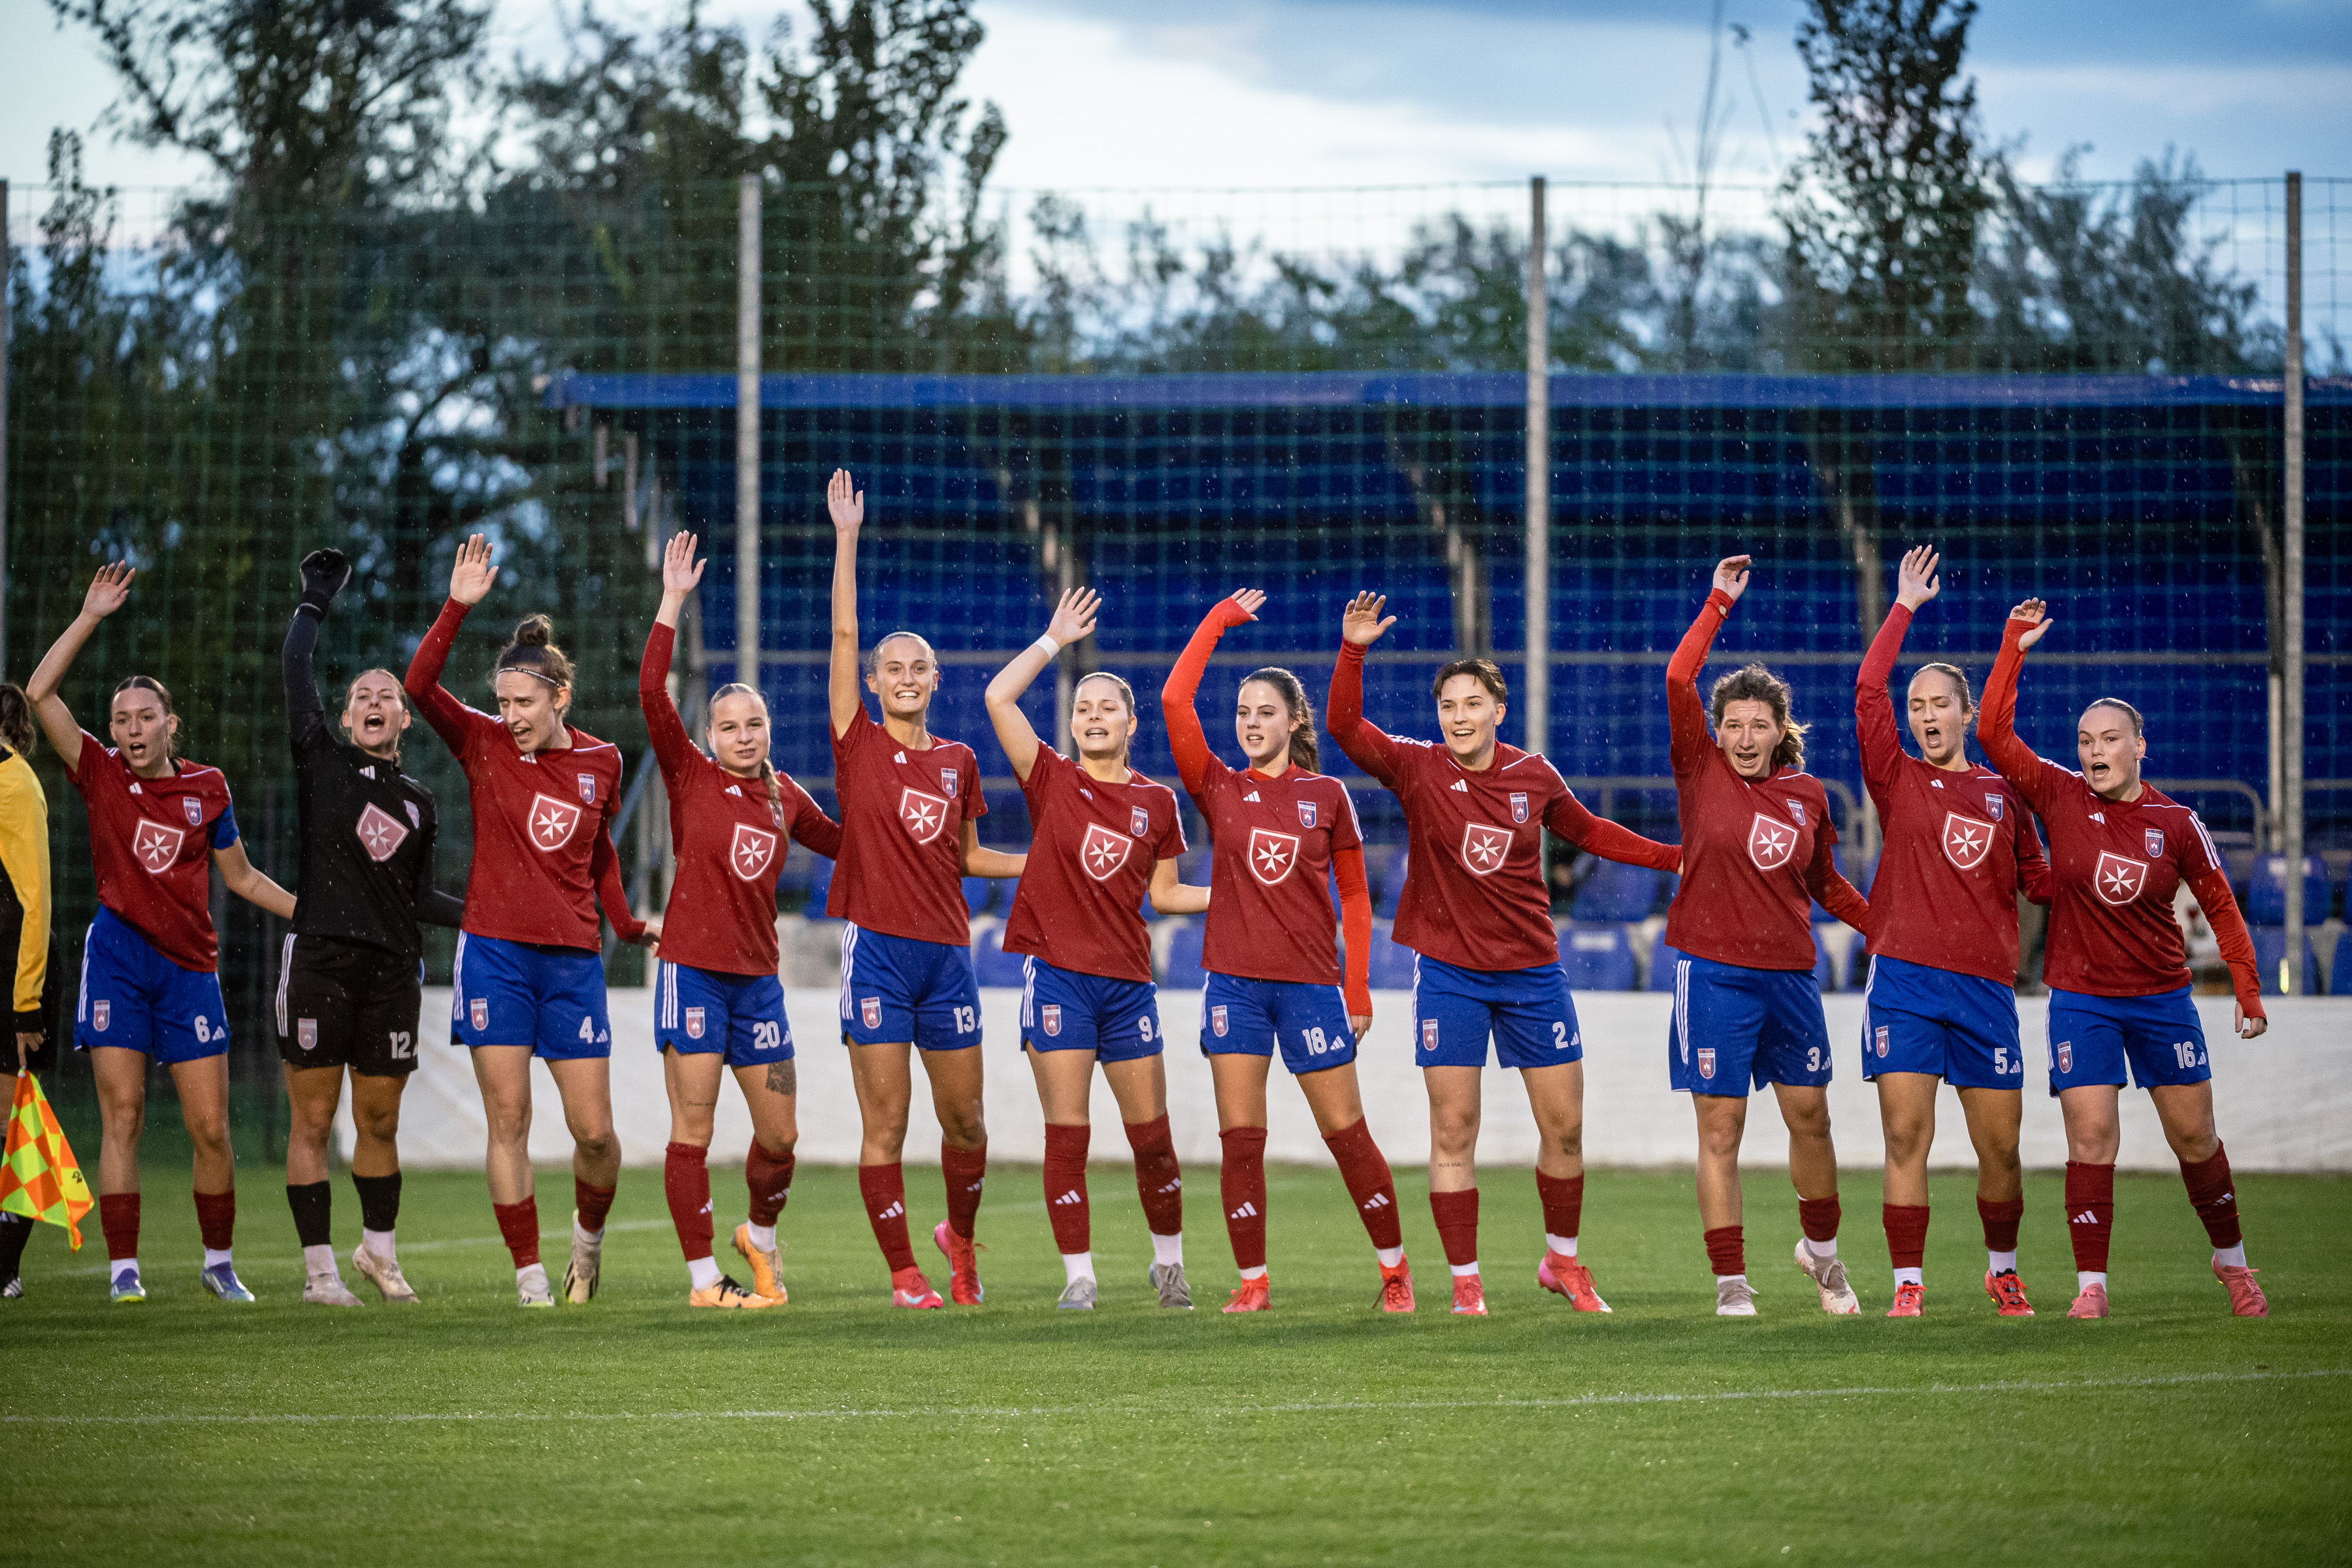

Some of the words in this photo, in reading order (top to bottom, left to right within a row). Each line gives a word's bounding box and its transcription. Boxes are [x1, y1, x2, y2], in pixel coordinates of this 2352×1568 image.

[195, 1015, 210, 1043] 6
[579, 1016, 595, 1044] 4
[953, 1005, 975, 1034] 13
[1138, 1015, 1153, 1043] 9
[389, 1032, 411, 1059] 12
[753, 1021, 781, 1050] 20
[1301, 1026, 1328, 1056] 18
[1552, 1021, 1569, 1049] 2
[1806, 1047, 1820, 1072] 3
[1994, 1047, 2008, 1075] 5
[2173, 1041, 2196, 1069] 16
